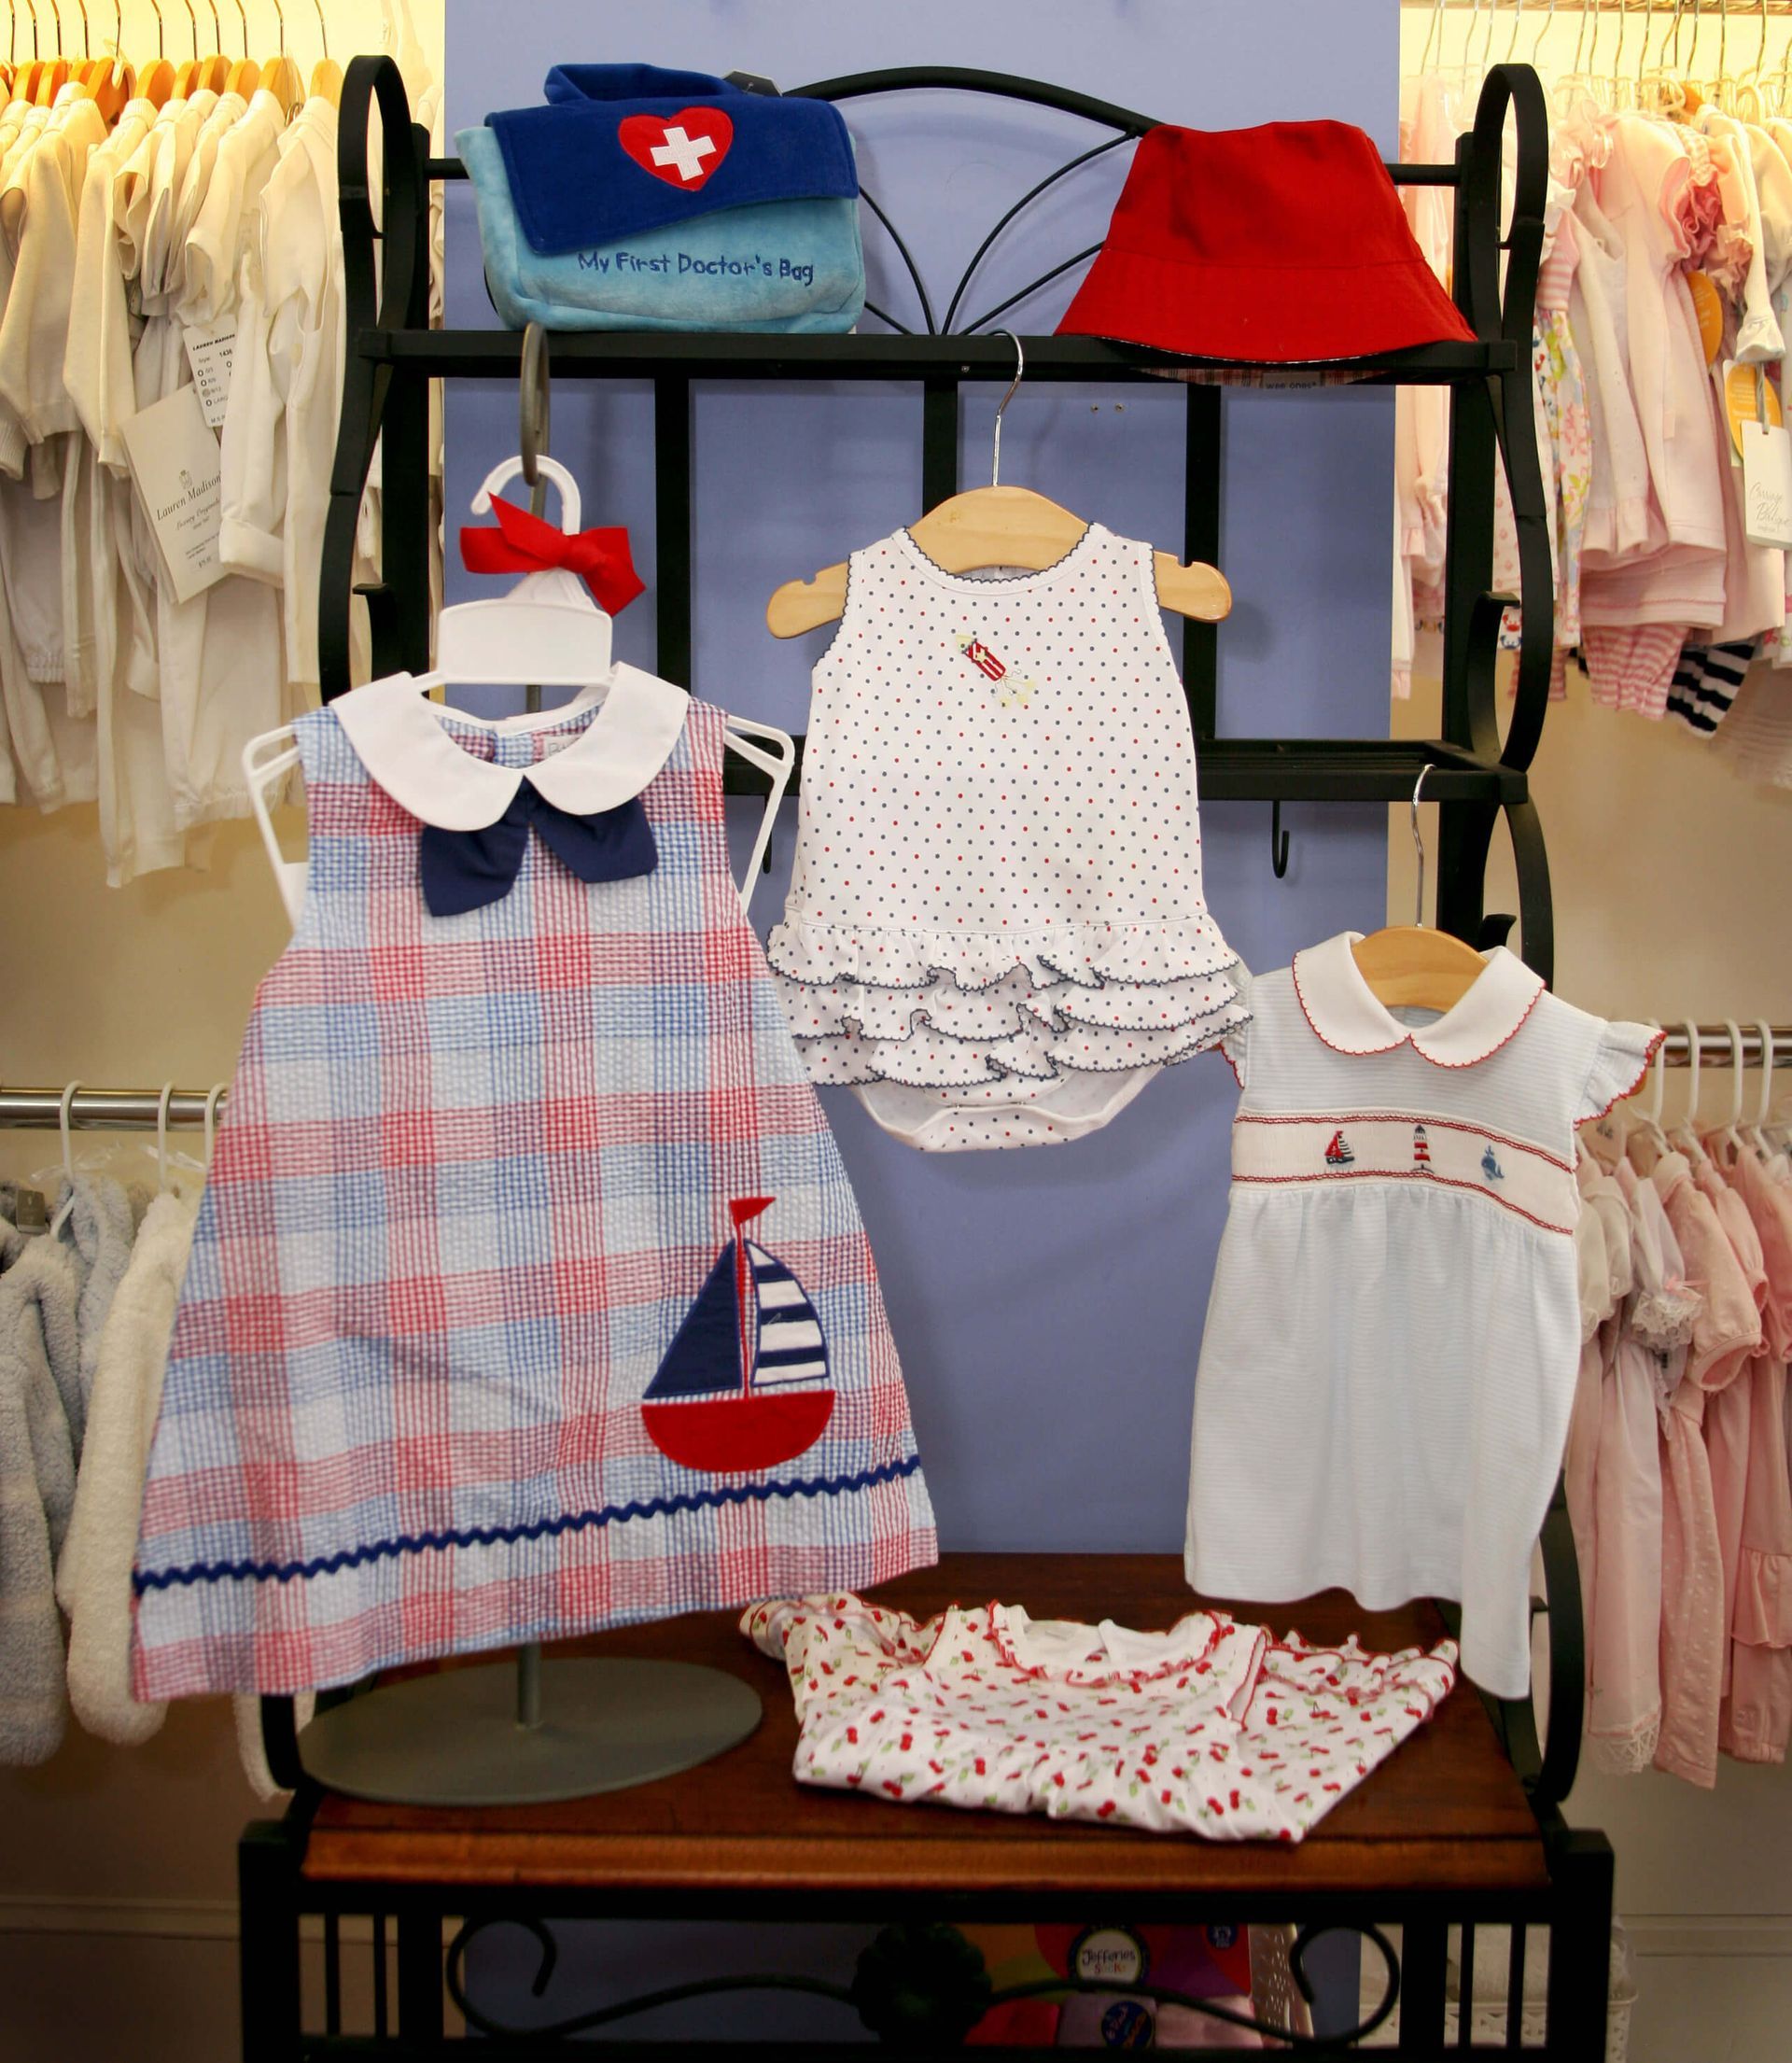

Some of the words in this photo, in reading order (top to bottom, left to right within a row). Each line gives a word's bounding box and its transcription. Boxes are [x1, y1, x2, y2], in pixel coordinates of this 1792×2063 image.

[577, 250, 609, 274] My
[615, 251, 671, 274] First
[678, 252, 773, 277] Doctor's
[778, 258, 814, 287] Bag
[157, 497, 187, 521] Lauren
